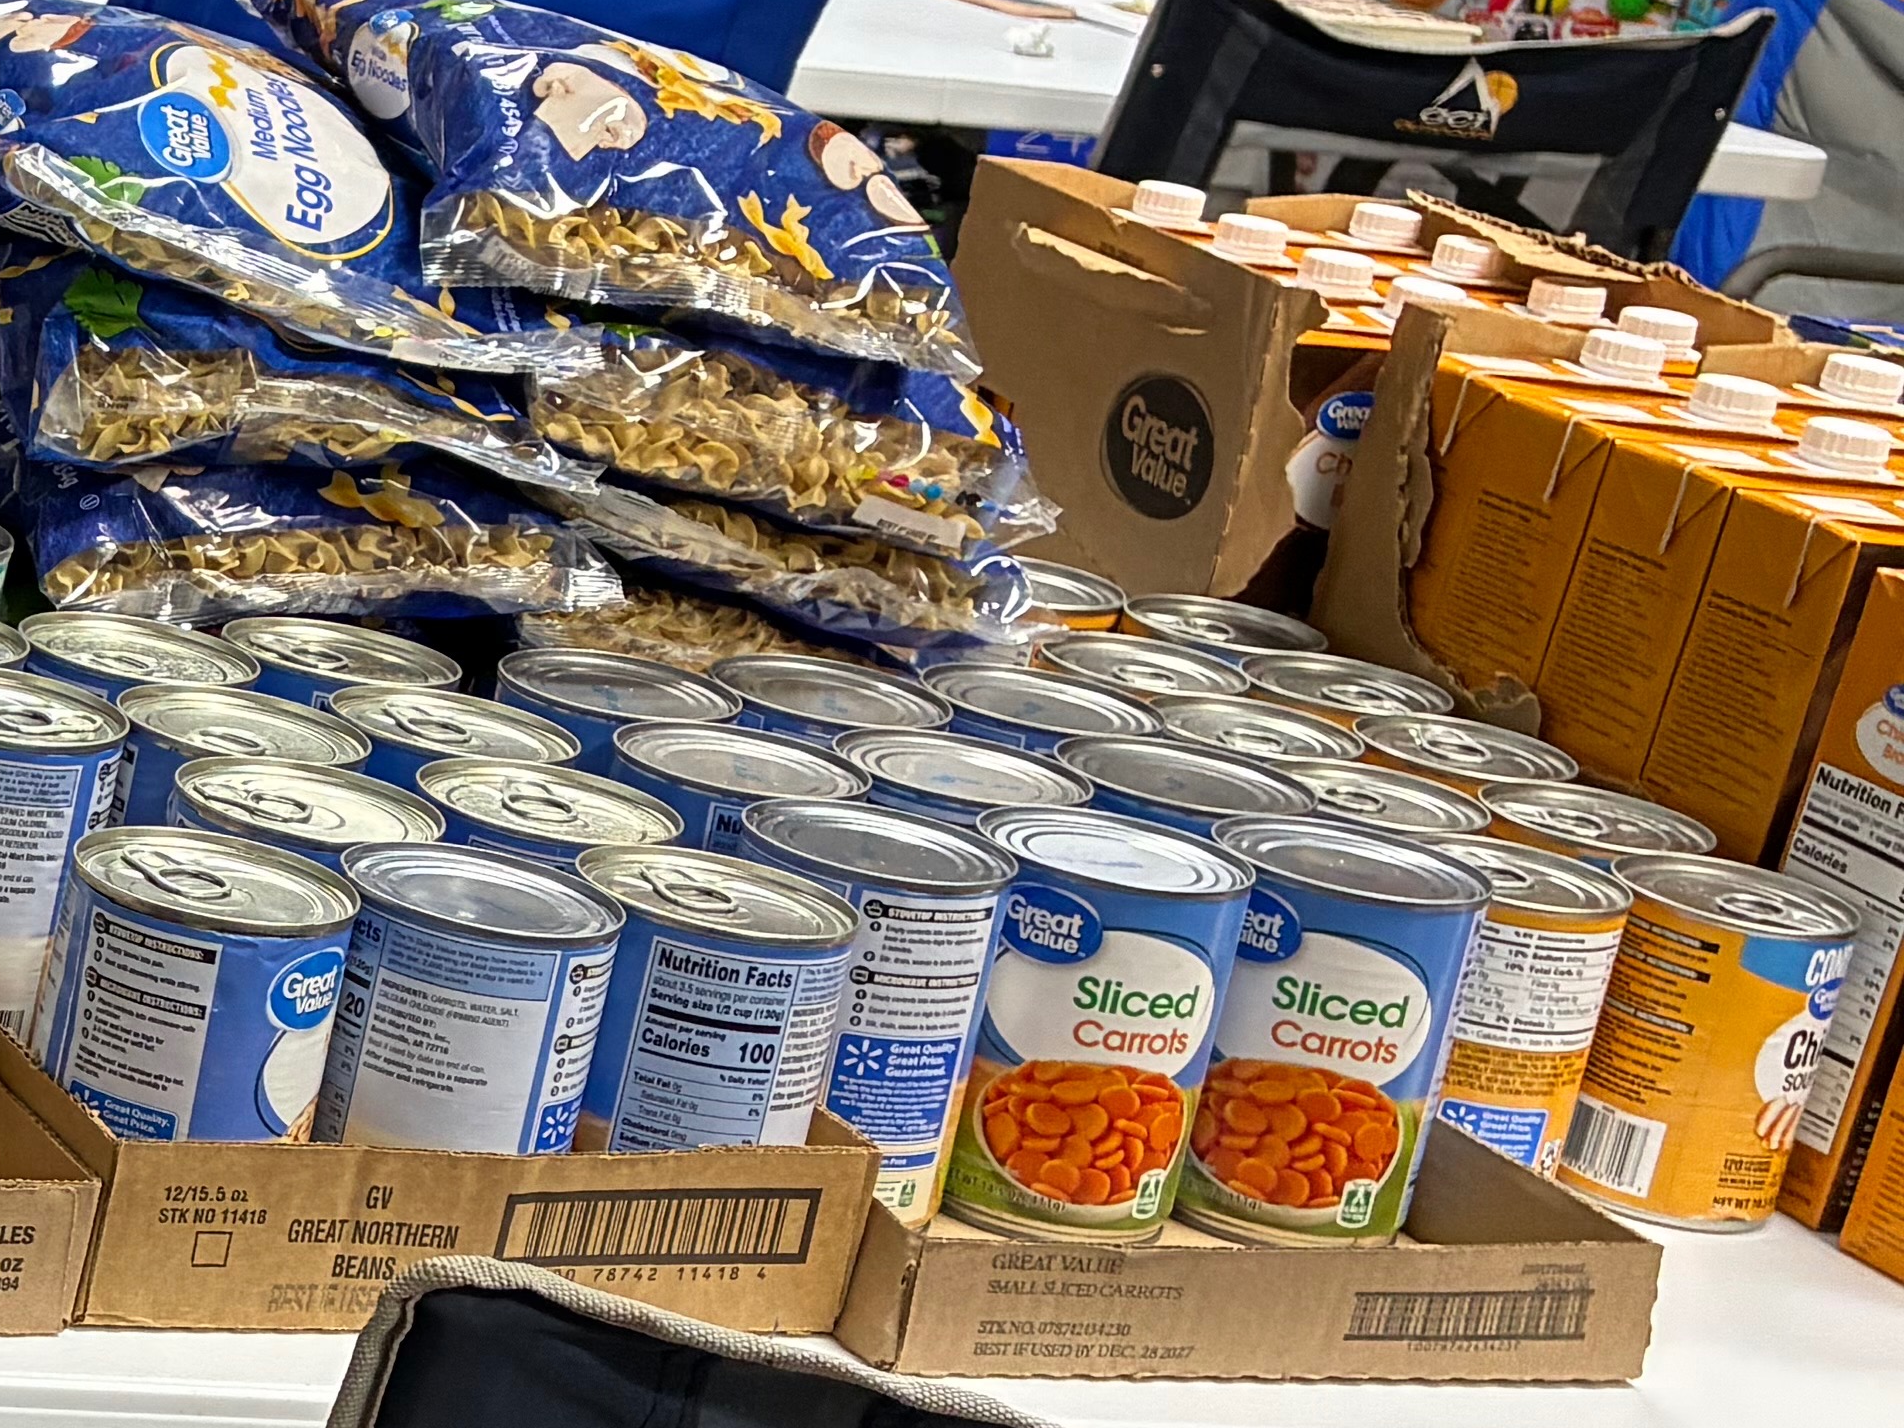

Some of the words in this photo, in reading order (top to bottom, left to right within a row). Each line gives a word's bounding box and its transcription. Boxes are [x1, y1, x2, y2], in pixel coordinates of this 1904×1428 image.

[163, 104, 192, 167] Great
[190, 114, 213, 162] Value
[252, 88, 278, 162] Medium
[281, 77, 316, 166] Noodles
[286, 168, 334, 233] Egg
[1120, 398, 1195, 468] Great
[1130, 445, 1189, 500] Value
[1816, 766, 1894, 809] Nutrition
[1007, 894, 1084, 938] Great
[1018, 921, 1080, 955] Value
[283, 968, 338, 1001] Great
[658, 947, 740, 984] Nutrition
[745, 966, 792, 988] Facts
[295, 993, 334, 1015] Value
[1073, 975, 1201, 1020] Sliced
[1272, 975, 1410, 1028] Sliced
[642, 1028, 710, 1058] Calories
[739, 1042, 775, 1064] 100
[1073, 1020, 1189, 1055] Carrots
[1271, 1020, 1398, 1064] Carrots
[164, 1186, 226, 1204] 12/15.5
[230, 1188, 249, 1202] oz
[365, 1186, 394, 1210] GV
[158, 1208, 190, 1224] STK
[192, 1209, 216, 1224] NO
[221, 1209, 268, 1225] 11418
[287, 1218, 349, 1244] GREAT
[351, 1220, 460, 1249] NORTHERN
[0, 1257, 24, 1273] oz
[331, 1254, 397, 1280] BEANS
[992, 1253, 1056, 1271] GREAT
[1061, 1254, 1126, 1275] VALUE
[987, 1280, 1037, 1295] SMALL
[1100, 1285, 1184, 1300] CARROTS
